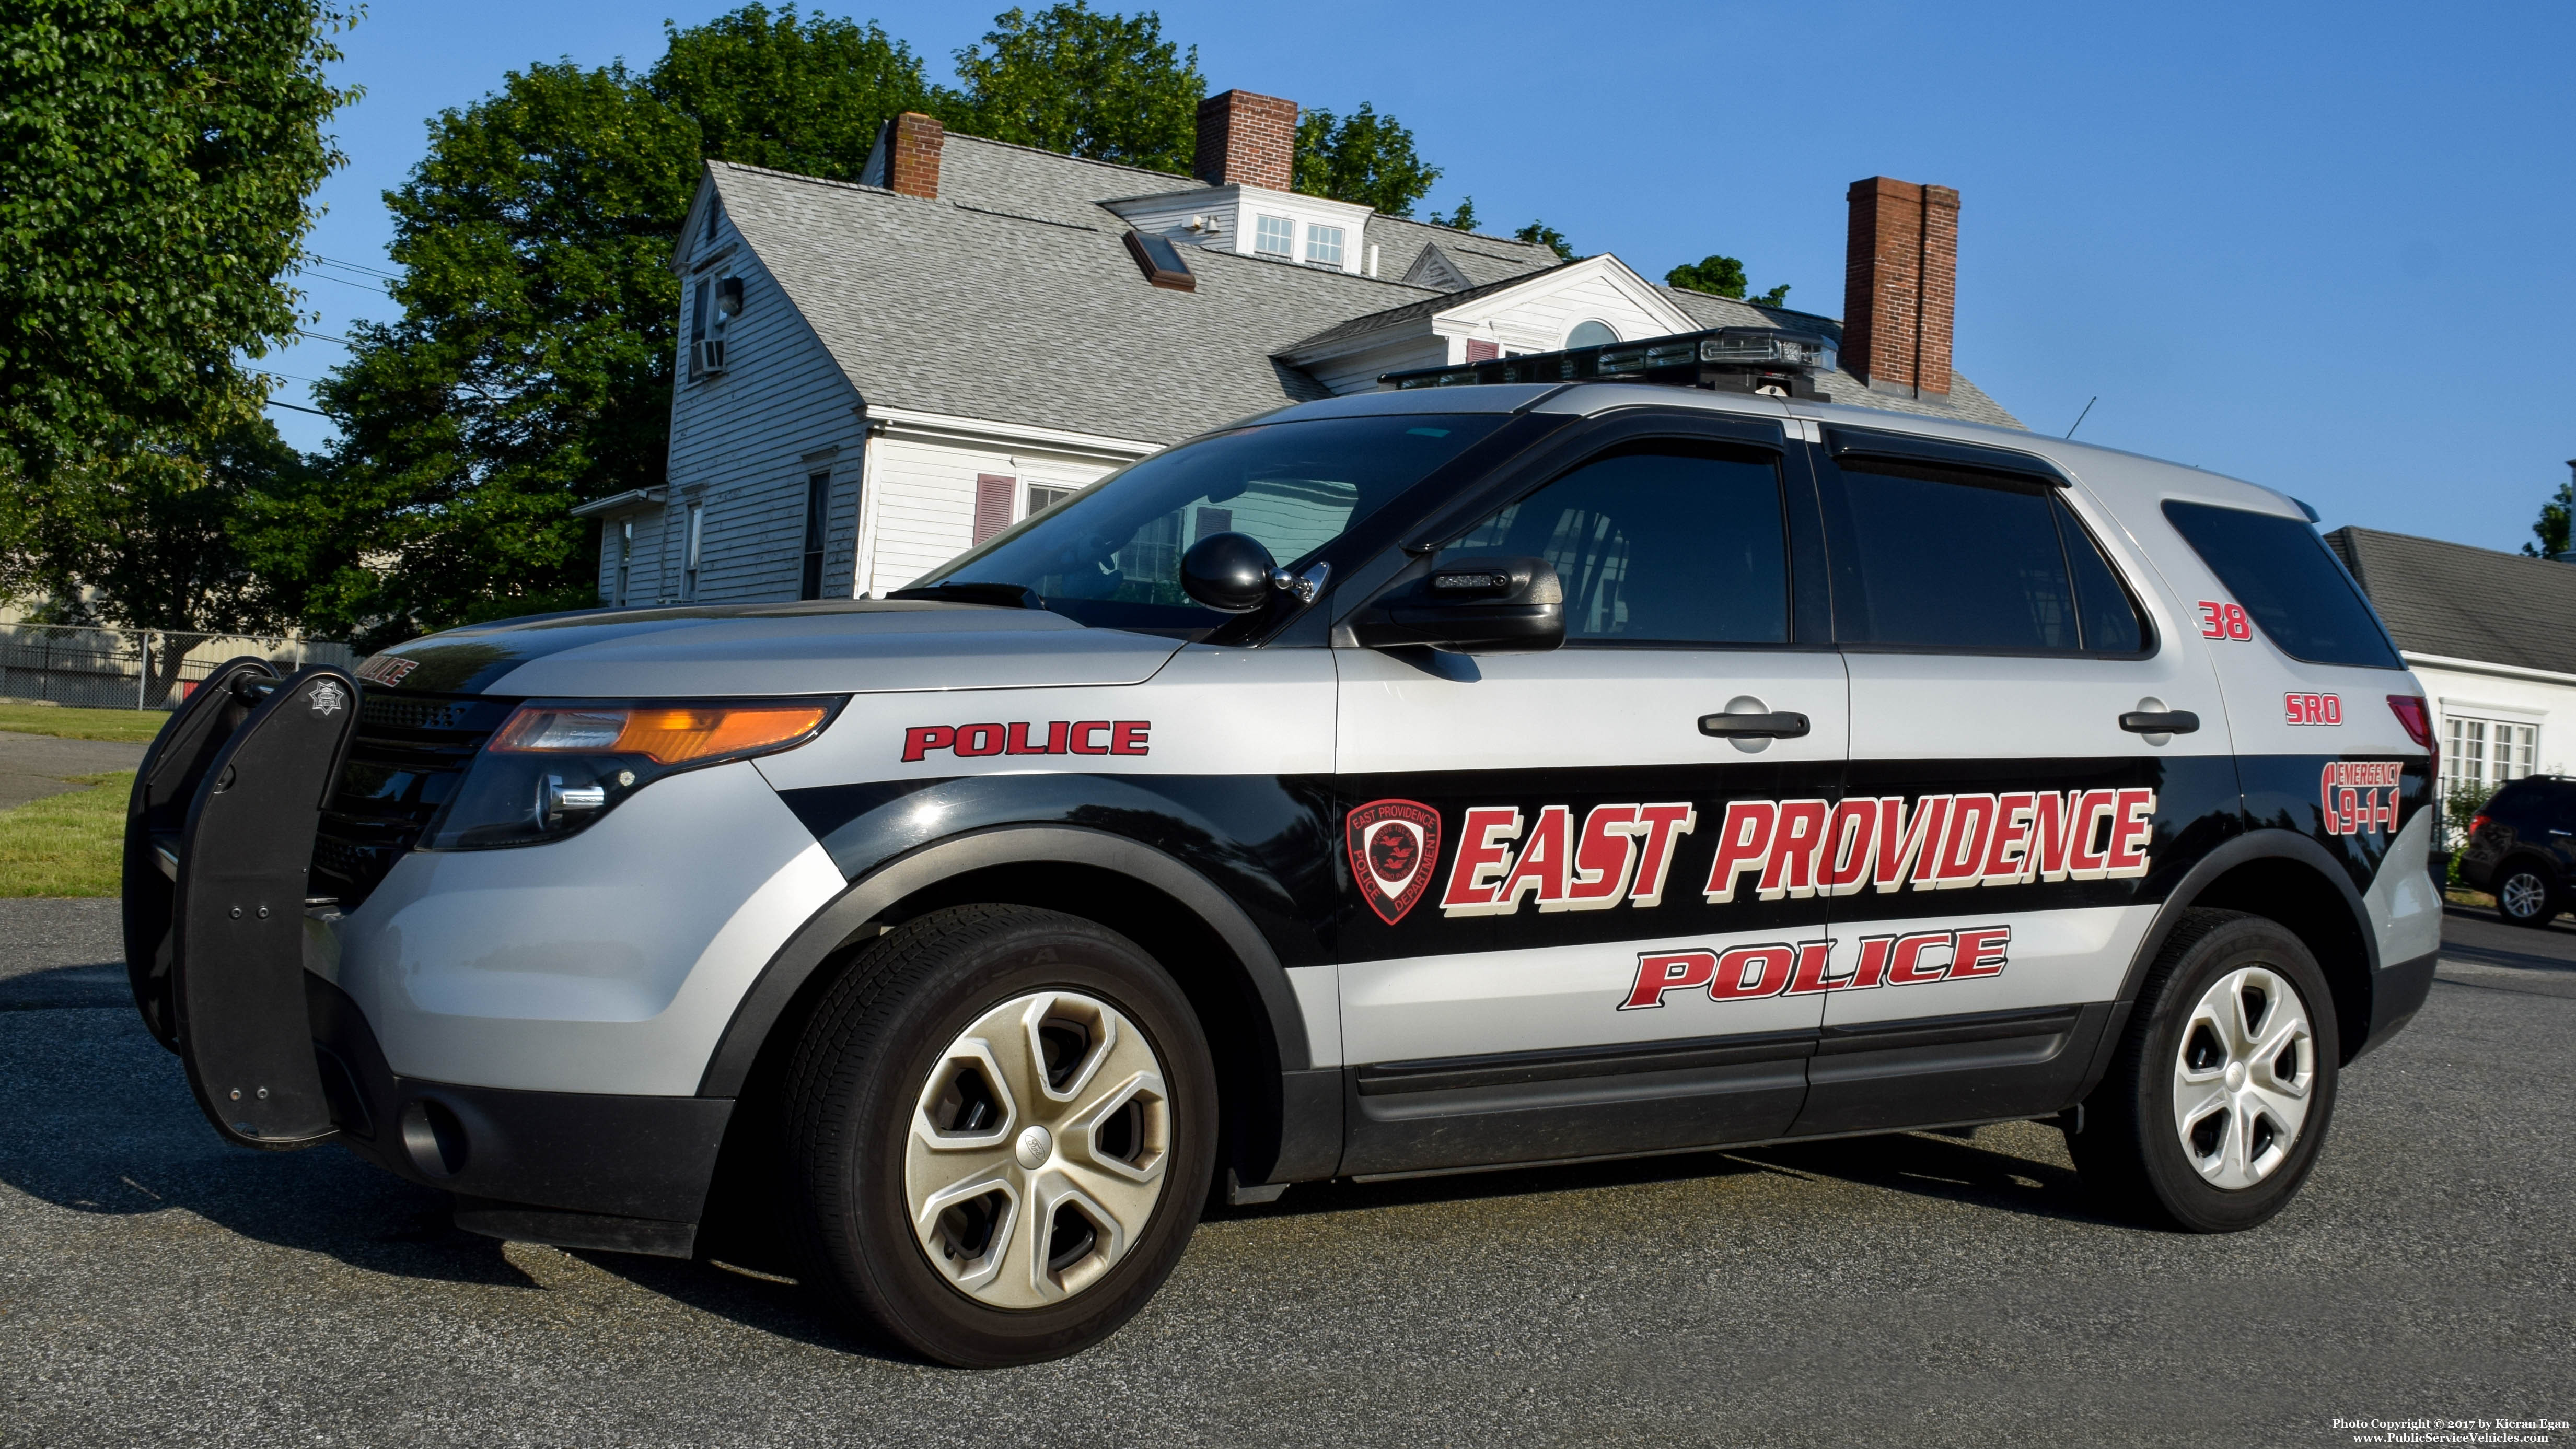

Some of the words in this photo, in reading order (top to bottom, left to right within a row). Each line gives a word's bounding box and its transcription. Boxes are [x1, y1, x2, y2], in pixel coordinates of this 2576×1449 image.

[2198, 600, 2253, 641] 38
[2284, 692, 2343, 726] SRO
[900, 720, 1151, 763] POLICE
[2337, 762, 2404, 787] EMERGENCY
[1352, 809, 1376, 829] EAST
[1379, 805, 1436, 828] PROVIDENCE
[2339, 787, 2399, 835] 9-1-1
[1372, 825, 1393, 845] RHODE
[1395, 825, 1415, 846] ISLAND
[1440, 802, 1697, 918] EAST
[1702, 788, 2156, 904] PROVIDENCE
[1354, 849, 1381, 901] POLICE
[1394, 831, 1436, 912] DEPARTMENT
[1616, 925, 2011, 1011] POLICE
[1027, 1138, 1043, 1158] Ford
